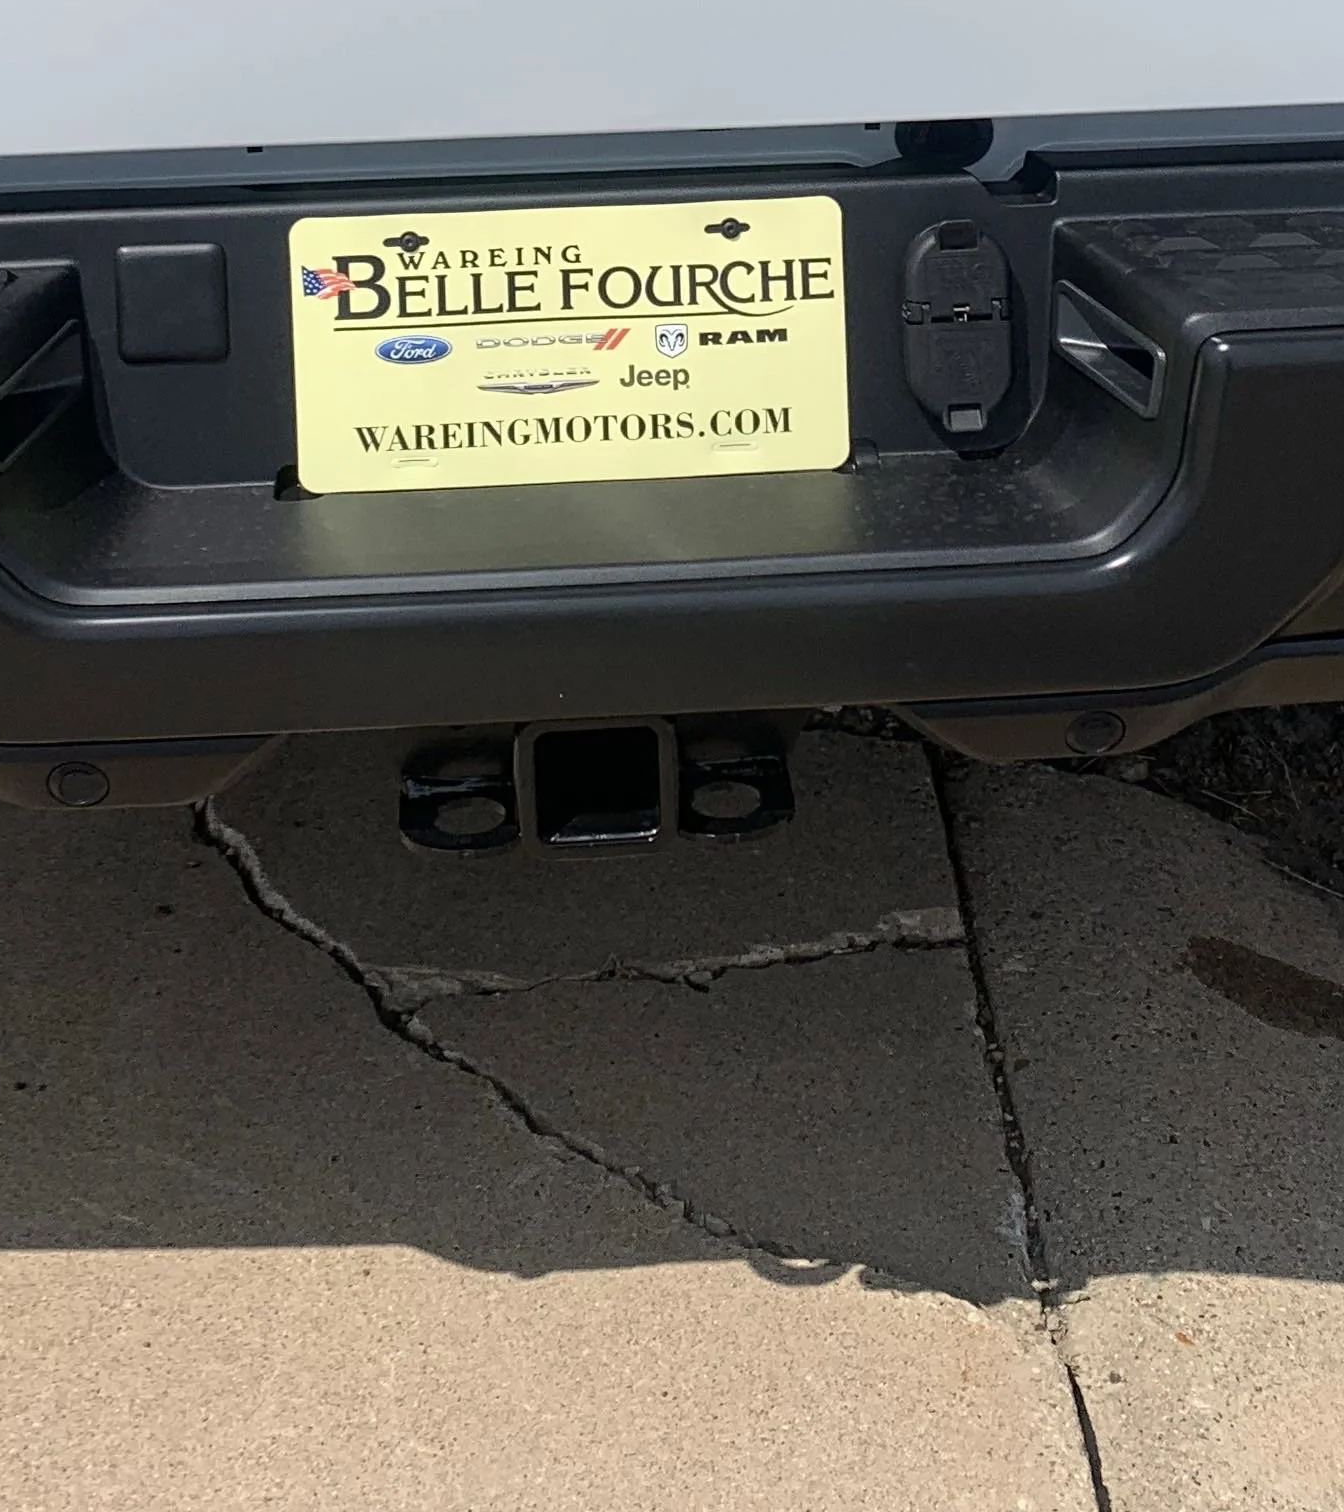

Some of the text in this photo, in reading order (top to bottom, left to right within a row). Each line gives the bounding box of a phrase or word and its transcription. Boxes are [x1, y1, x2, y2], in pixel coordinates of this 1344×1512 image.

[397, 245, 583, 270] WAREING
[332, 254, 835, 321] BELLE FOURCHE
[476, 332, 607, 349] DODGE
[699, 328, 788, 346] RAM
[619, 364, 690, 390] Jeep
[354, 406, 793, 454] WAREINGMOTORS.COM
